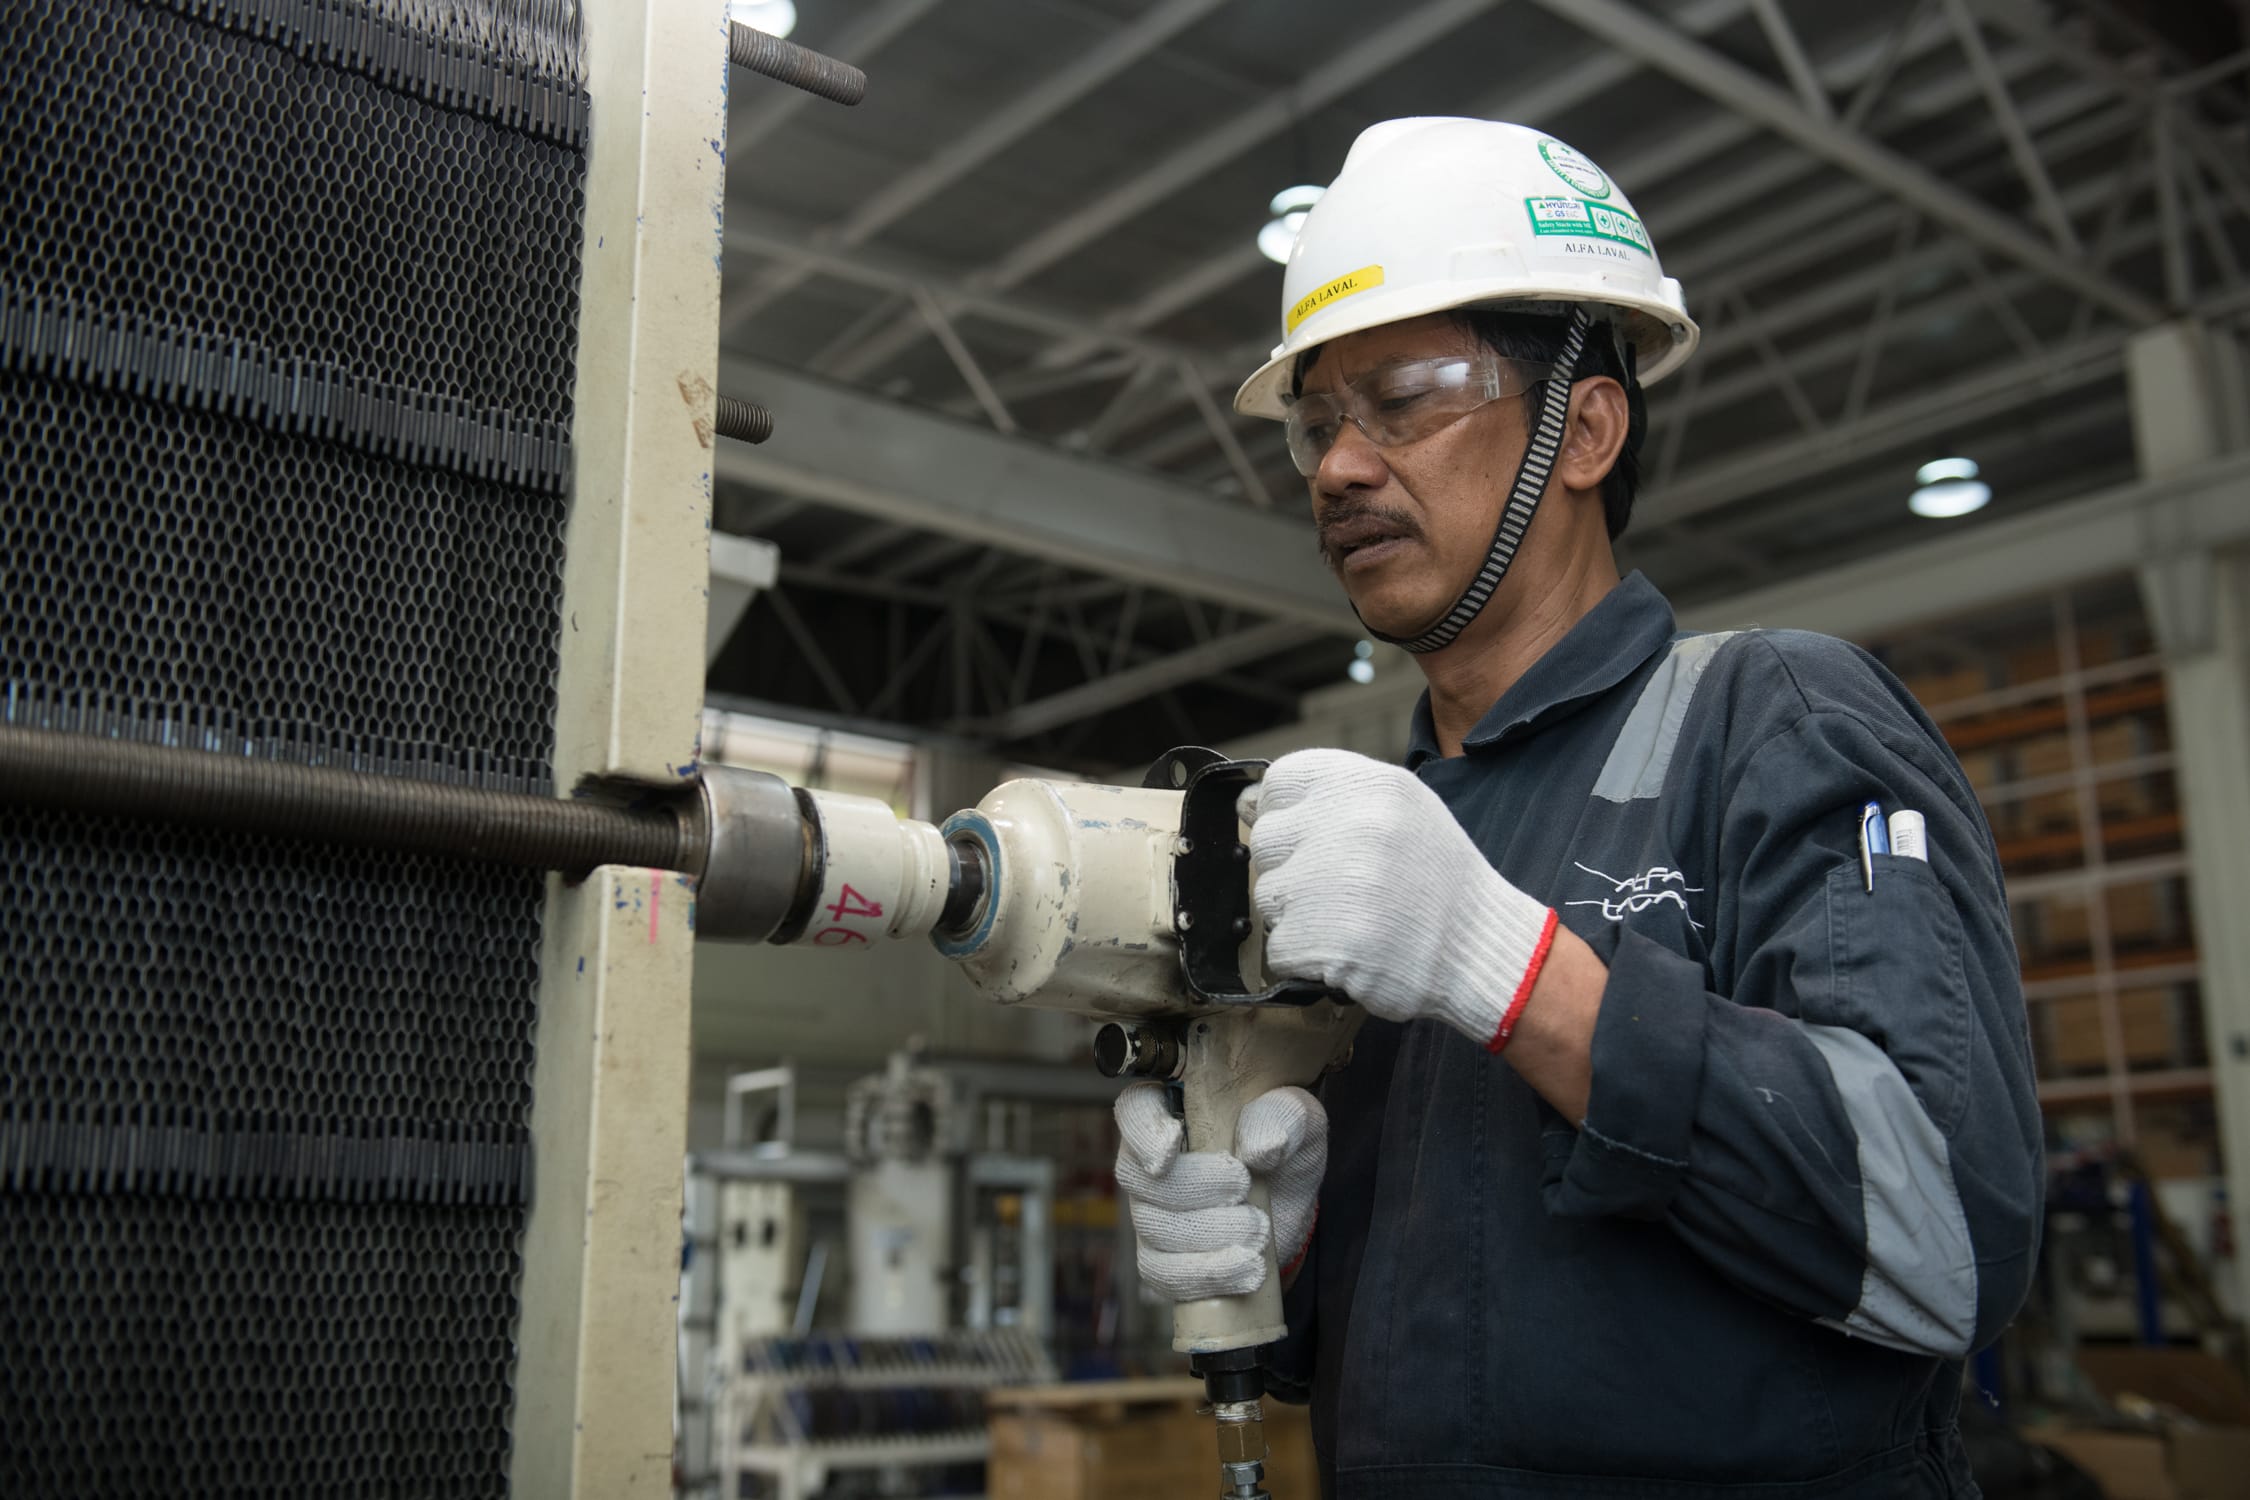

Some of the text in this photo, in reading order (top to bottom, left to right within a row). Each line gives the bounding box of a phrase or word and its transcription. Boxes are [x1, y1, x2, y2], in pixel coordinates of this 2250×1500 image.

[1565, 243, 1631, 261] ALFA LAVAL
[1296, 279, 1358, 319] ALFA LAVAL
[813, 883, 883, 946] 46
